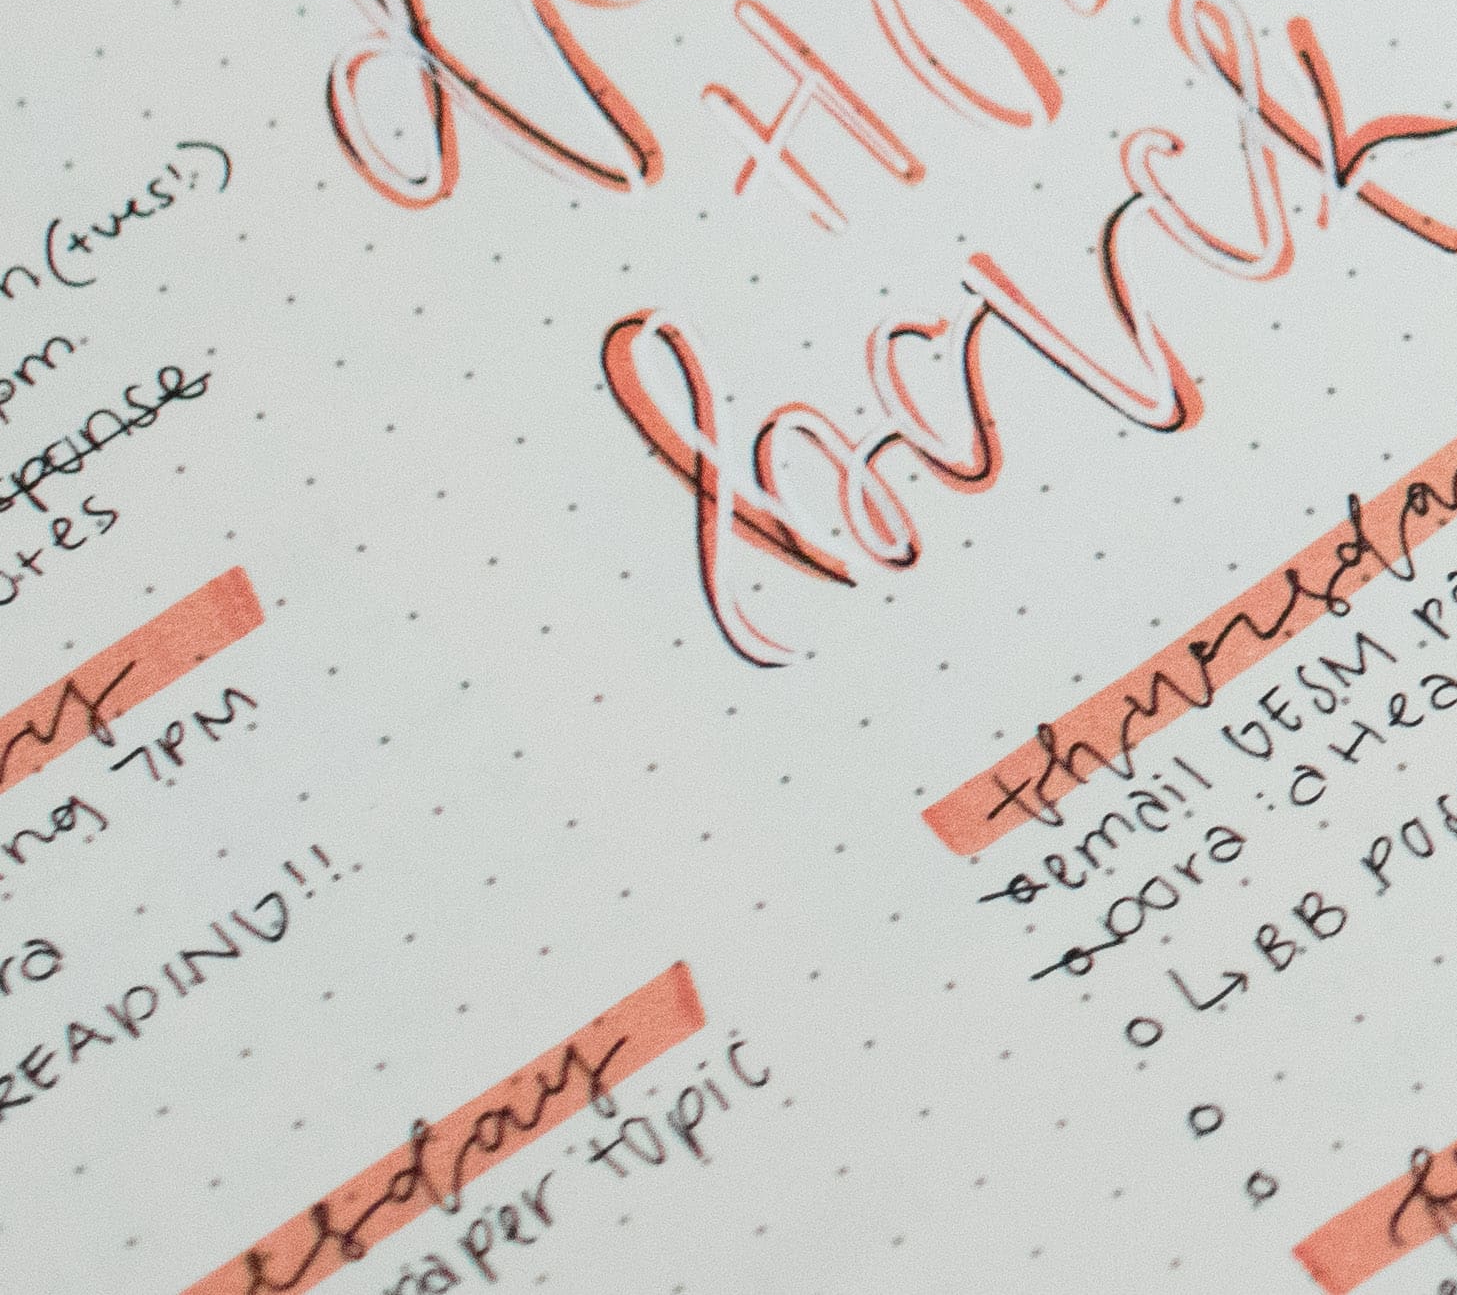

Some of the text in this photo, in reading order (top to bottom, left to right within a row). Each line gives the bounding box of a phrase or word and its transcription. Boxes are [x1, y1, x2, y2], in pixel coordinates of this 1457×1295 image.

[108, 686, 259, 781] 7PM
[1041, 756, 1213, 892] email
[1252, 890, 1349, 974] BB
[586, 1039, 771, 1178] topic
